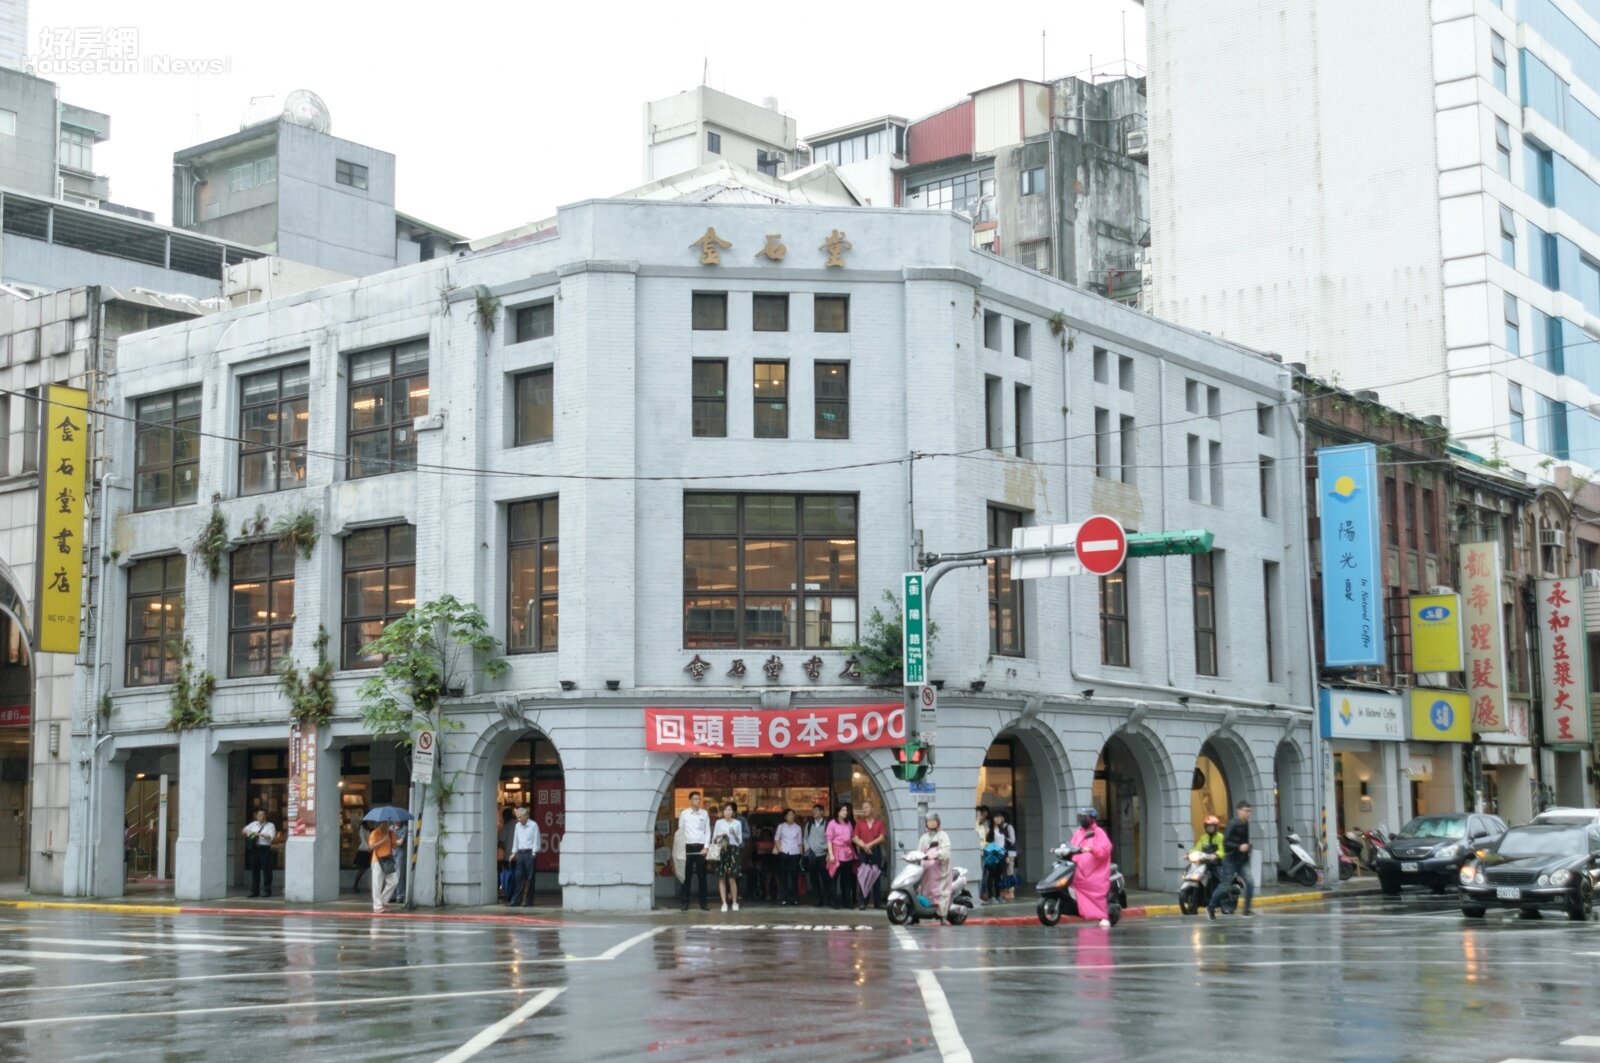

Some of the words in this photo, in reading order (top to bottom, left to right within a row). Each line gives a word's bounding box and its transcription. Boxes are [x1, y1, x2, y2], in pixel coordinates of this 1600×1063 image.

[688, 226, 853, 269] 金石堂
[48, 416, 80, 593] 金石堂書店
[908, 584, 920, 645] 衡陽路
[1361, 624, 1371, 649] Coffee
[1464, 550, 1499, 726] 凱帝理髮廳
